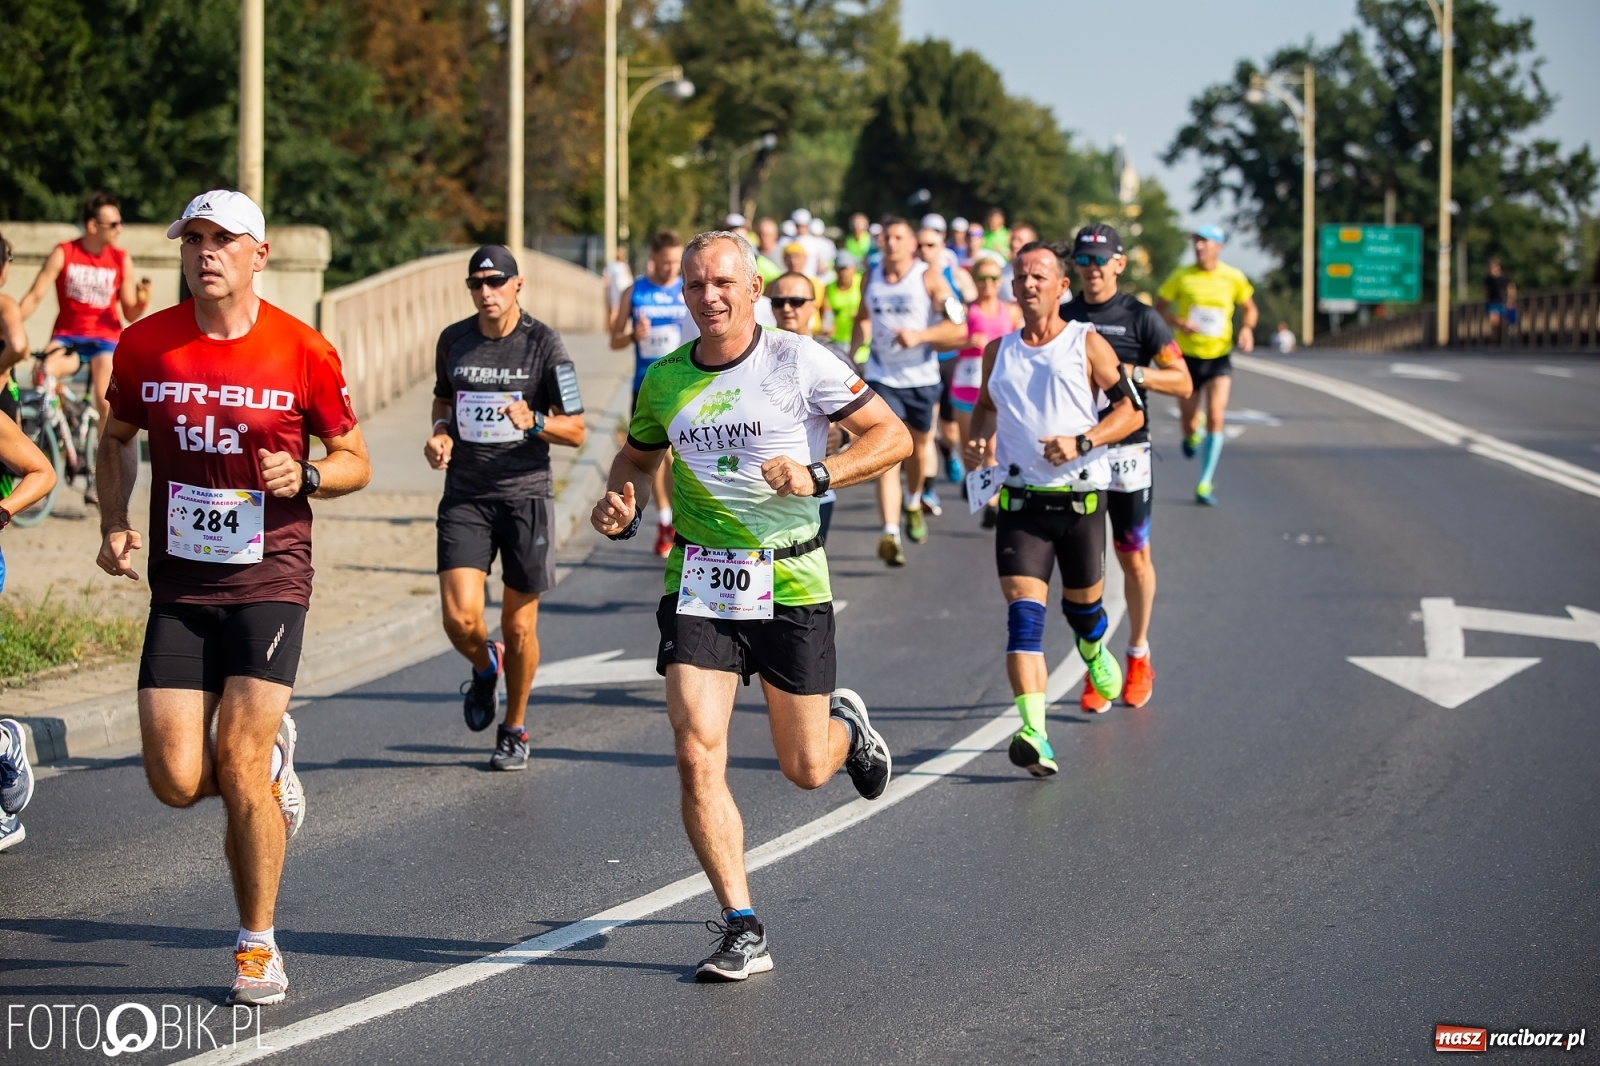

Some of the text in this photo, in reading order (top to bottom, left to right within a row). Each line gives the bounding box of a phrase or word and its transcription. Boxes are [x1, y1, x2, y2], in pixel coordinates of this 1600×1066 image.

[653, 355, 684, 370] deep
[453, 366, 530, 380] PITBULL
[468, 376, 511, 385] SPORTS
[141, 381, 295, 411] DAR-BUD
[679, 421, 762, 445] AKTYWNI
[696, 438, 746, 451] LYSKI
[196, 490, 224, 498] RAFAKO
[192, 507, 240, 534] 284
[710, 566, 751, 591] 300
